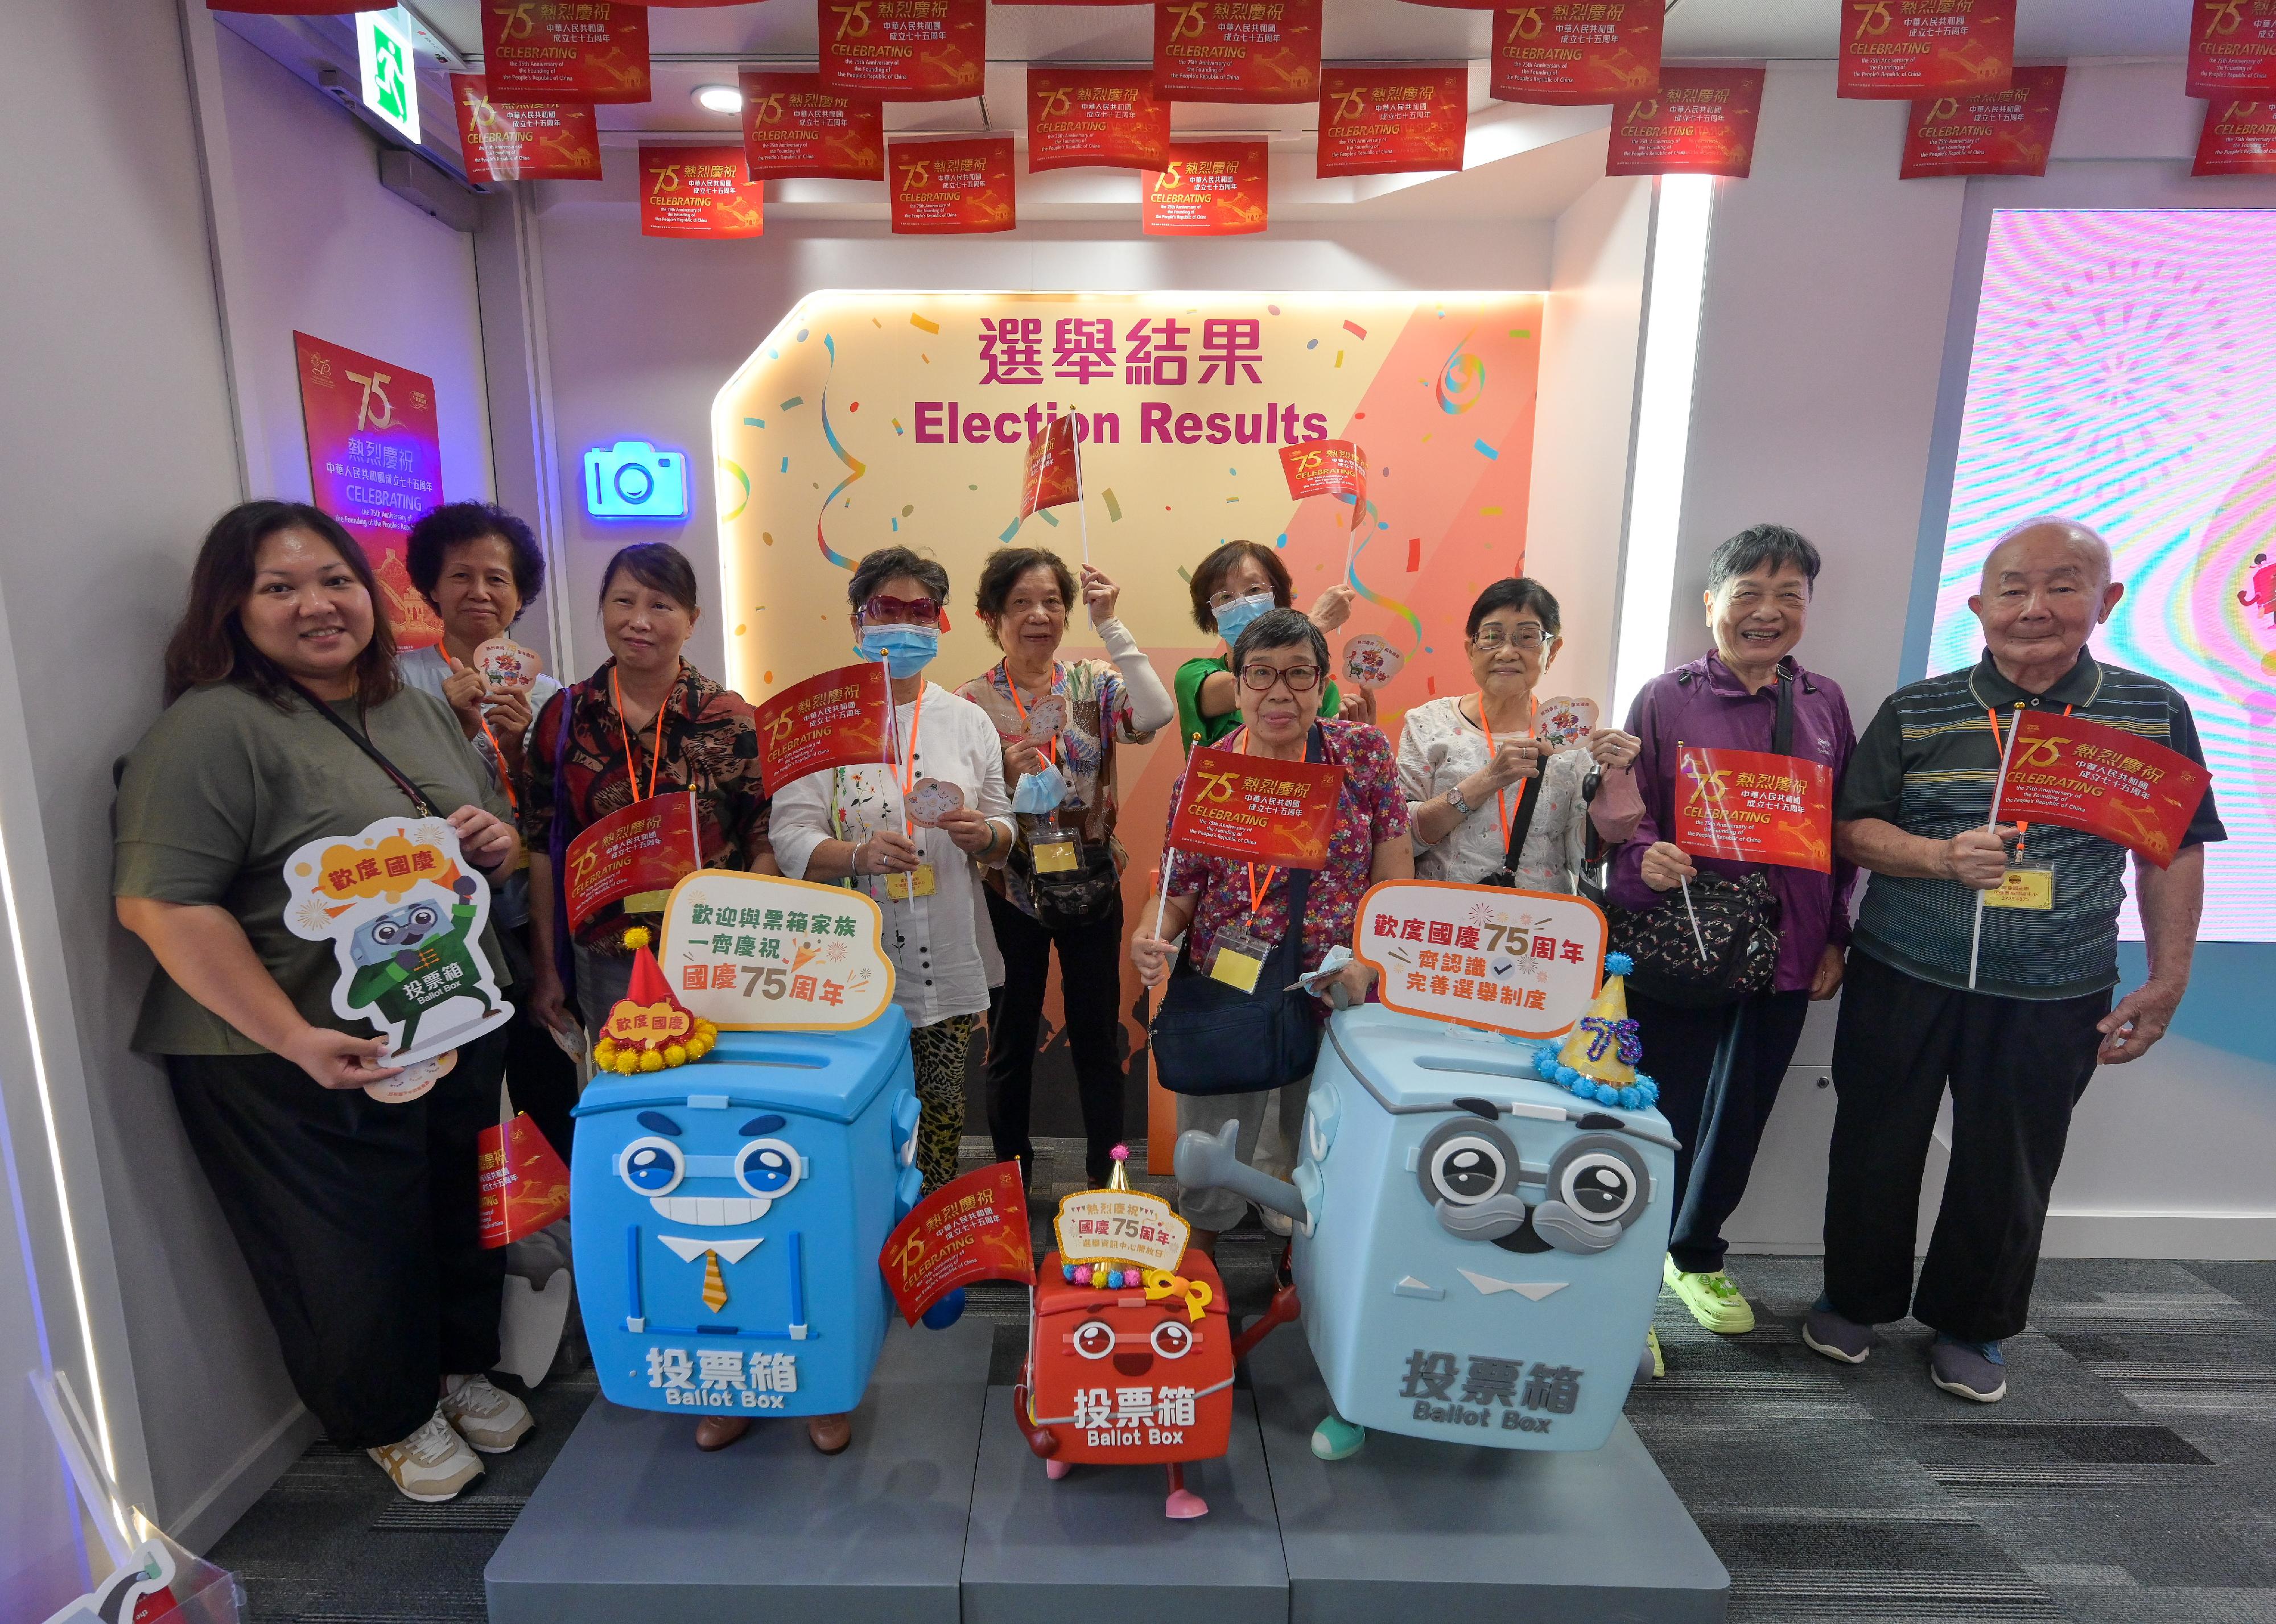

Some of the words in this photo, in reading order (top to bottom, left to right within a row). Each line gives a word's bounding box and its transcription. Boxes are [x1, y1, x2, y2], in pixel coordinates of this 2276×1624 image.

[540, 5, 610, 20] 熱烈慶祝
[877, 1, 947, 18] 熱烈慶祝
[1212, 3, 1284, 21] 熱烈慶祝
[1550, 5, 1625, 21] 熱烈慶祝
[1899, 0, 1975, 14] 熱烈慶祝
[493, 3, 535, 43] 75
[547, 24, 604, 33] 中華人民共和國
[831, 1, 872, 41] 75
[884, 21, 941, 30] 中華人民共和國
[1167, 2, 1209, 41] 75
[1218, 23, 1276, 33] 中華人民共和國
[1506, 3, 1548, 43] 75
[1556, 24, 1615, 34] 中華人民共和國
[1854, 0, 1896, 40] 75
[1904, 16, 1965, 27] 中華人民共和國
[554, 34, 611, 43] 成立七十五周年
[890, 31, 946, 40] 成立七十五周年
[1224, 34, 1280, 43] 成立七十五周年
[1561, 35, 1619, 43] 成立七十五周年
[1909, 26, 1969, 37] 成立七十五周年
[496, 46, 577, 59] CELEBRATING
[831, 44, 913, 57] CELEBRATING
[1165, 44, 1247, 59] CELEBRATING
[1501, 46, 1583, 60] CELEBRATING
[1848, 42, 1932, 55] CELEBRATING
[1037, 88, 1073, 121] 75
[1077, 88, 1138, 102] 熱烈慶祝
[1370, 87, 1434, 101] 熱烈慶祝
[1665, 90, 1730, 104] 熱烈慶祝
[463, 96, 497, 131] 75
[750, 94, 785, 127] 75
[1330, 88, 1367, 124] 75
[1375, 103, 1426, 112] 中華人民共和國
[1380, 112, 1430, 120] 成立七十五周年
[468, 131, 533, 144] CELEBRATING
[751, 130, 819, 141] CELEBRATING
[1036, 122, 1106, 133] CELEBRATING
[1327, 124, 1400, 137] CELEBRATING
[1620, 126, 1694, 137] CELEBRATING
[684, 166, 736, 178] 熱烈慶祝
[933, 158, 986, 172] 熱烈慶祝
[1185, 161, 1239, 174] 熱烈慶祝
[649, 165, 680, 194] 75
[899, 161, 930, 191] 75
[938, 173, 981, 182] 中華人民共和國
[943, 180, 986, 189] 成立七十五周年
[650, 196, 711, 206] CELEBRATING
[900, 192, 960, 202] CELEBRATING
[1151, 194, 1211, 203] CELEBRATING
[979, 318, 1262, 385] 選舉結果
[344, 370, 391, 431] 75
[1140, 402, 1327, 444] Results
[348, 437, 413, 473] 熱烈慶祝
[1290, 451, 1322, 473] 75
[326, 462, 432, 492] 中華人民共和國成立七十五周年
[1296, 469, 1355, 480] CELEBRATING
[346, 485, 421, 512] CELEBRATING
[345, 516, 367, 527] Founding
[382, 521, 399, 530] People's
[382, 511, 406, 522] Anniversary
[798, 684, 859, 715] 熱烈慶祝
[803, 702, 855, 722] 中華人民共和國
[810, 709, 861, 728] 成立七十五周年
[763, 706, 794, 751] 75
[768, 726, 831, 762] CELEBRATING
[2013, 736, 2073, 769] 75
[2072, 743, 2166, 784] 熱烈慶祝
[1735, 772, 1808, 795] 熱烈慶祝
[2006, 772, 2105, 797] CELEBRATING
[2076, 760, 2149, 790] 中華人民共和國
[2079, 770, 2151, 800] 成立七十五周年
[1195, 772, 1240, 803] 75
[1241, 777, 1311, 798] 熱烈慶祝
[1687, 770, 1733, 805] 75
[1741, 790, 1800, 805] 中華人民共和國
[1245, 794, 1300, 808] 中華人民共和國
[1249, 803, 1302, 817] 成立七十五周年
[1747, 800, 1805, 813] 成立七十五周年
[1188, 805, 1269, 827] CELEBRATING
[1684, 806, 1771, 823] CELEBRATING
[602, 815, 662, 849] 熱烈慶祝
[1219, 822, 1246, 832] Anniversary
[607, 831, 656, 854] 中華人民共和國
[611, 838, 662, 860] 成立七十五周年
[1218, 834, 1237, 843] Republic
[328, 850, 437, 891] 歡度國慶
[571, 840, 599, 886] 75
[572, 856, 632, 898] CELEBRATING
[692, 904, 856, 938] 歡迎與票箱家族
[688, 933, 780, 959] 一齊慶祝
[1374, 913, 1585, 964] 歡度國慶75周年
[1419, 950, 1486, 978] 齊認識
[403, 962, 463, 1000] 投票箱
[683, 963, 844, 1007] 國慶75周年
[1406, 971, 1547, 1011] 完善選舉制度
[417, 988, 444, 1005] Ballot
[444, 979, 461, 992] Box
[617, 1015, 683, 1032] 歡度國慶
[1581, 1016, 1643, 1066] 75
[926, 1188, 995, 1234] 熱烈慶祝
[1086, 1203, 1139, 1217] 熱烈慶祝
[936, 1207, 993, 1237] 中華人民共和國
[946, 1215, 1001, 1240] 成立七十五周年
[1079, 1218, 1170, 1245] 國慶75周年
[892, 1227, 926, 1281] 75
[1083, 1239, 1164, 1258] 選舉資訊中心開放日
[903, 1235, 974, 1293] CELEBRATING
[646, 1347, 797, 1392] 投票箱
[1399, 1348, 1585, 1414] 投票箱
[666, 1388, 733, 1407] Ballot
[741, 1391, 784, 1408] Box
[1073, 1386, 1196, 1429] 投票箱
[1413, 1399, 1491, 1427] Ballot
[1502, 1409, 1553, 1434] Box
[1087, 1429, 1141, 1447] Ballot
[1149, 1429, 1184, 1445] Box
